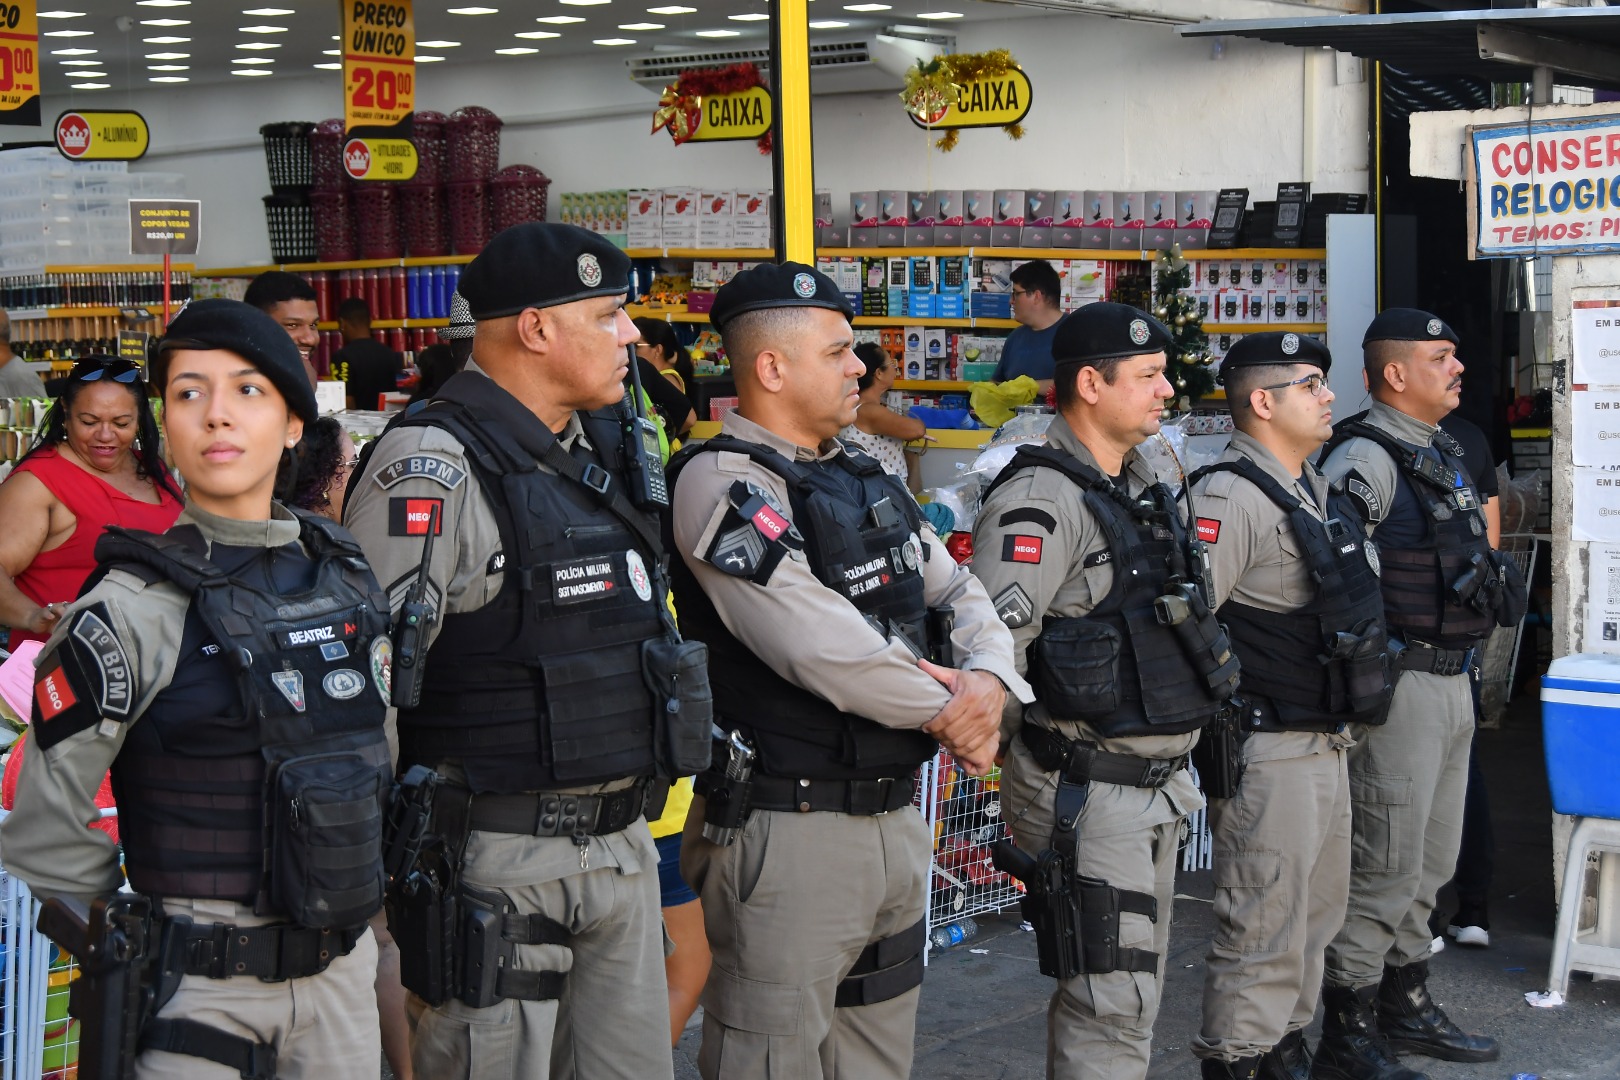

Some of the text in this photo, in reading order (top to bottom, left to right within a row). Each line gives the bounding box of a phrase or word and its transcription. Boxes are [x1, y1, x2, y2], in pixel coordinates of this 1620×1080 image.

[353, 1, 406, 28] PREÇO
[353, 26, 406, 56] ÚNICO
[352, 67, 397, 110] 20
[957, 80, 1019, 113] CAIXA
[708, 96, 764, 128] CAIXA
[103, 123, 138, 142] ALUMÍNIO
[378, 144, 411, 157] UTILIDADES
[1491, 133, 1620, 178] CONSER
[140, 209, 179, 217] CONJUNTO
[141, 220, 167, 228] COPOS
[1492, 221, 1593, 243] TEMOS:
[1595, 319, 1611, 327] EM
[387, 458, 454, 481] 1º BPM
[1365, 492, 1379, 511] BPM
[408, 513, 431, 521] NEG
[758, 511, 781, 533] NEGO
[1197, 526, 1215, 535] NEGO
[1015, 545, 1037, 553] NEGO
[556, 563, 611, 581] POLÍCIA MILITAR
[865, 556, 887, 571] MILITAR
[558, 586, 570, 598] SGT
[570, 580, 605, 596] NASCIMENTO
[849, 583, 860, 596] SGT
[289, 622, 357, 646] BEATRIZ A+
[89, 627, 127, 699] 1º BPM
[45, 676, 63, 710] NEGO
